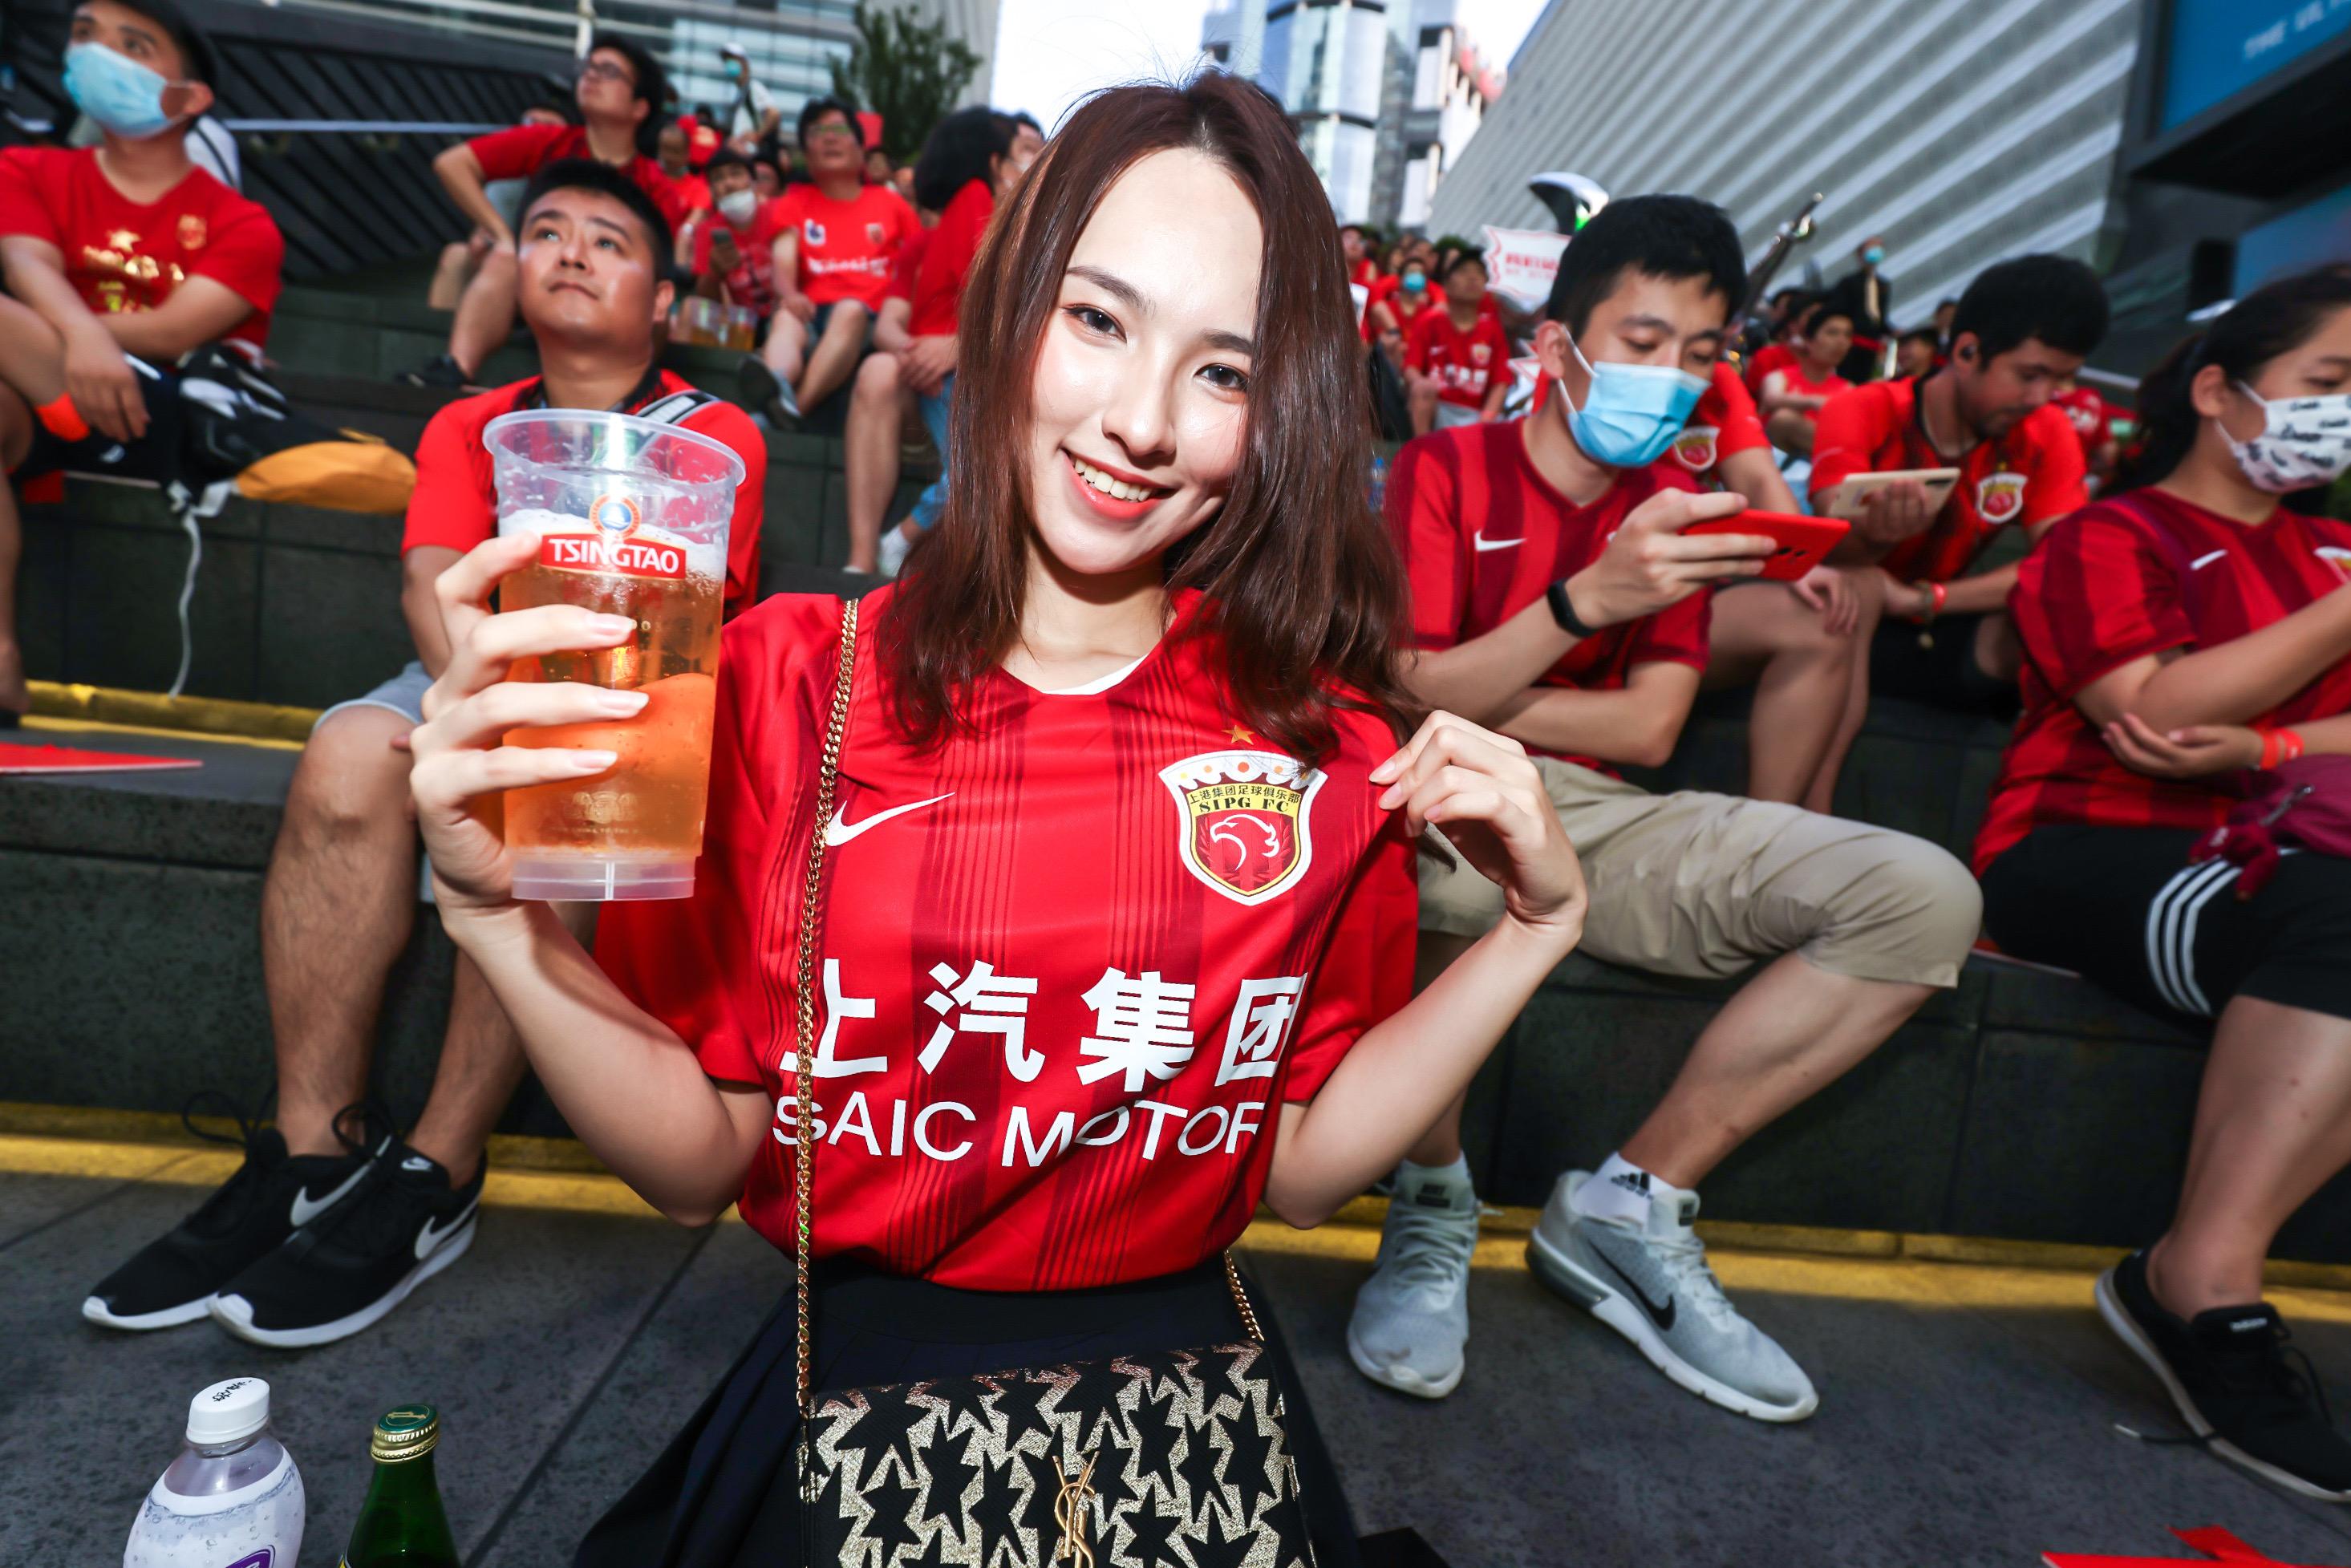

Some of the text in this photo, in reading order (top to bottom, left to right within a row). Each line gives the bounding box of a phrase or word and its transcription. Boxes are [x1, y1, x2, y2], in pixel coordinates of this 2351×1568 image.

[549, 538, 679, 573] TSINGTAO
[1190, 784, 1300, 804] 上港集团足球俱乐部
[1199, 796, 1289, 812] SIPG FC
[779, 958, 1307, 1092] 上汽集团
[772, 1090, 977, 1161] SAIC
